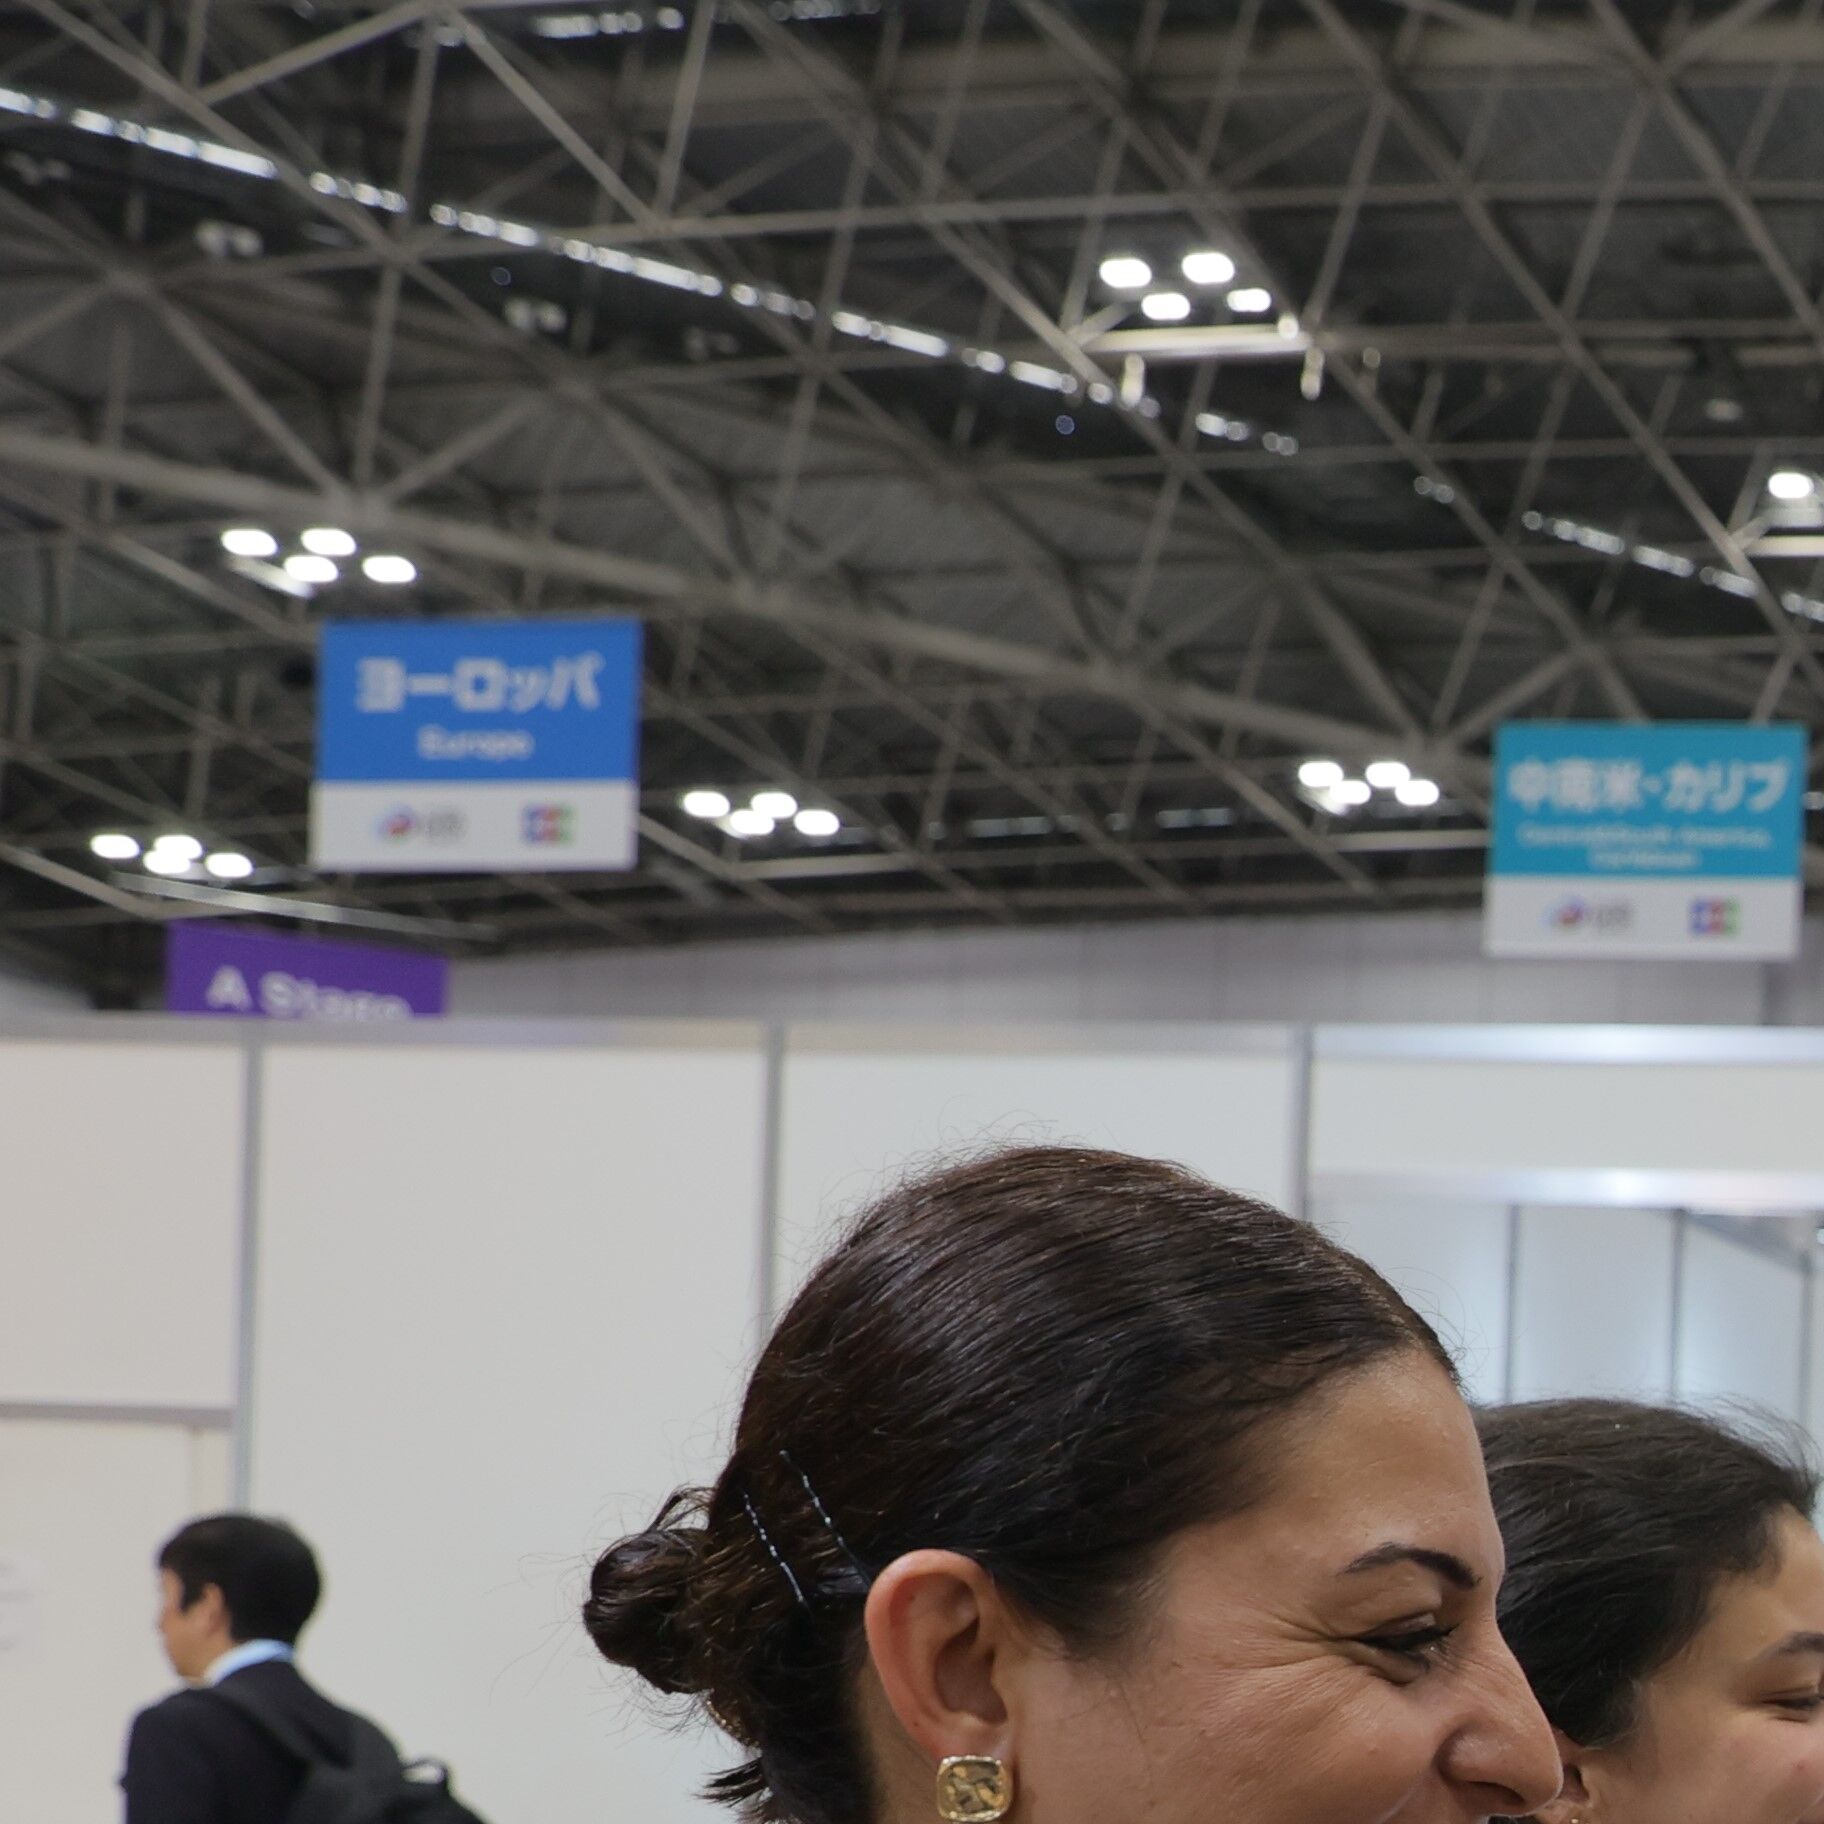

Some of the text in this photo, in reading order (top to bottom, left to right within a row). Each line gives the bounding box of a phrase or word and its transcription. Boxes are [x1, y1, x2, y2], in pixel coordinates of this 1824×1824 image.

[356, 652, 604, 713] ヨーロッパ
[416, 725, 535, 762] Europe
[207, 966, 253, 1010] A
